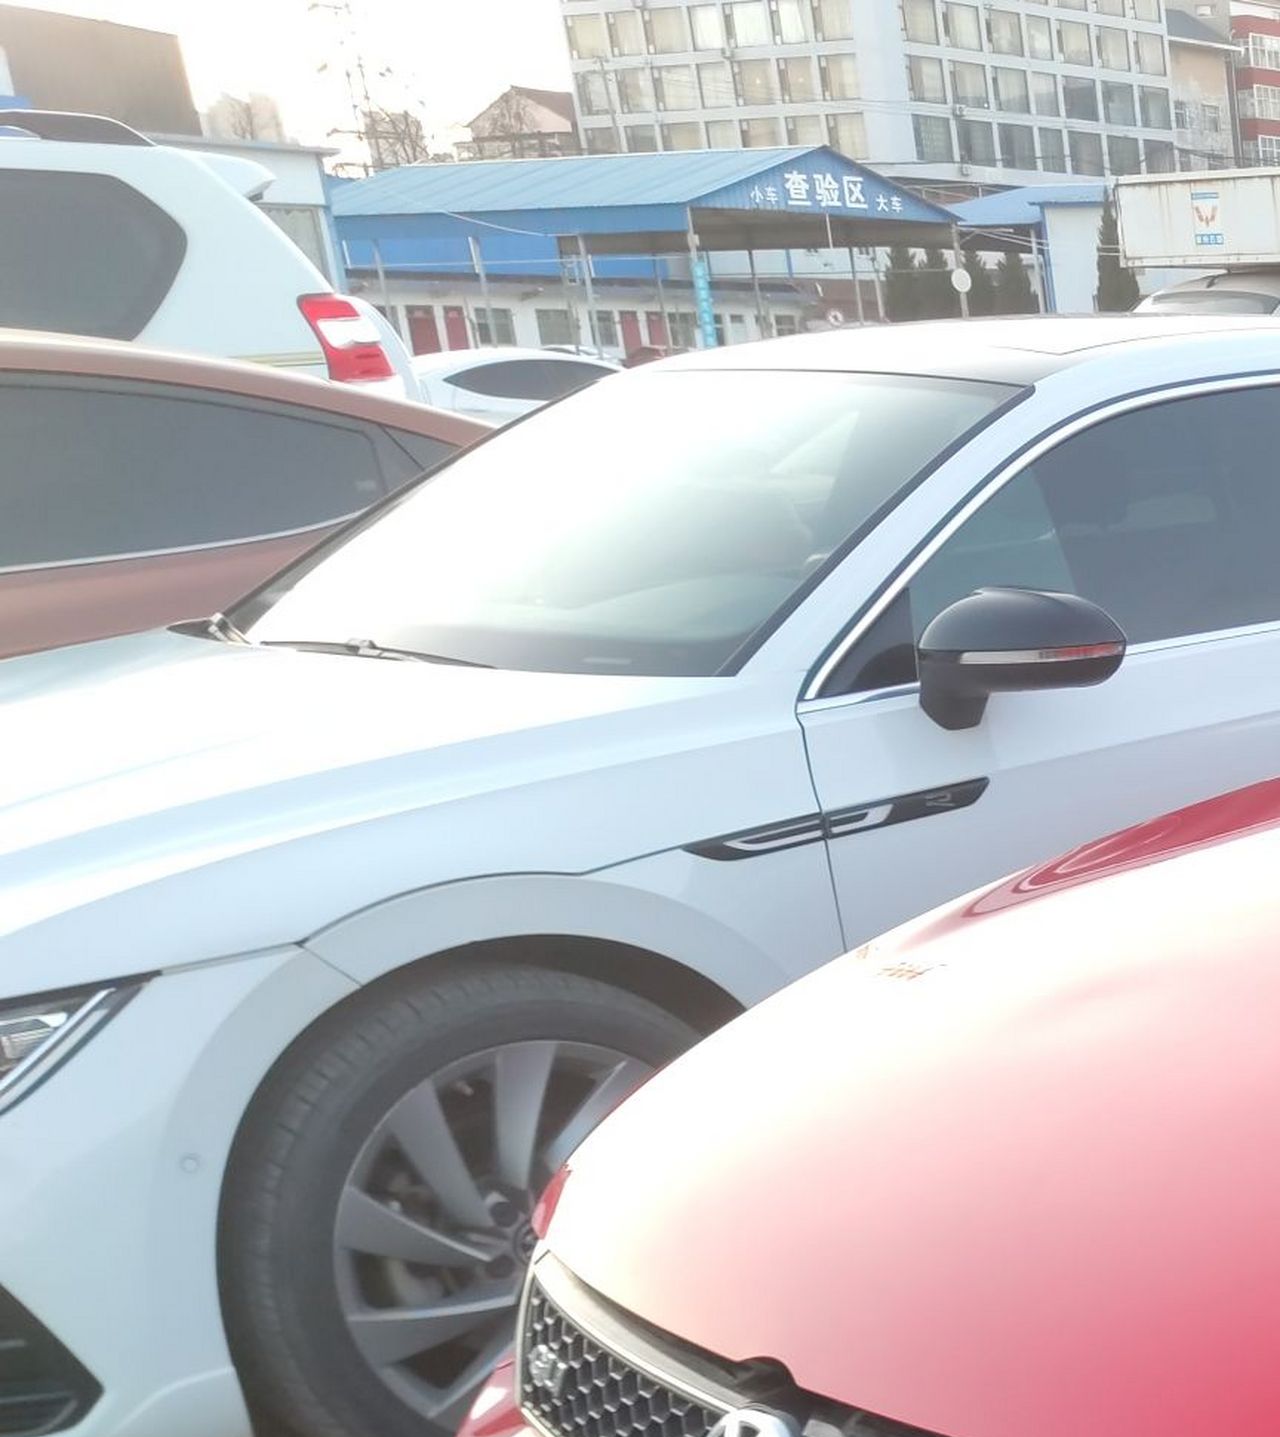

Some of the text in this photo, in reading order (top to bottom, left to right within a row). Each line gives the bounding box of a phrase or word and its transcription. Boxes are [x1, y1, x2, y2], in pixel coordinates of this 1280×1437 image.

[750, 171, 903, 212] 小车 查验区 大车
